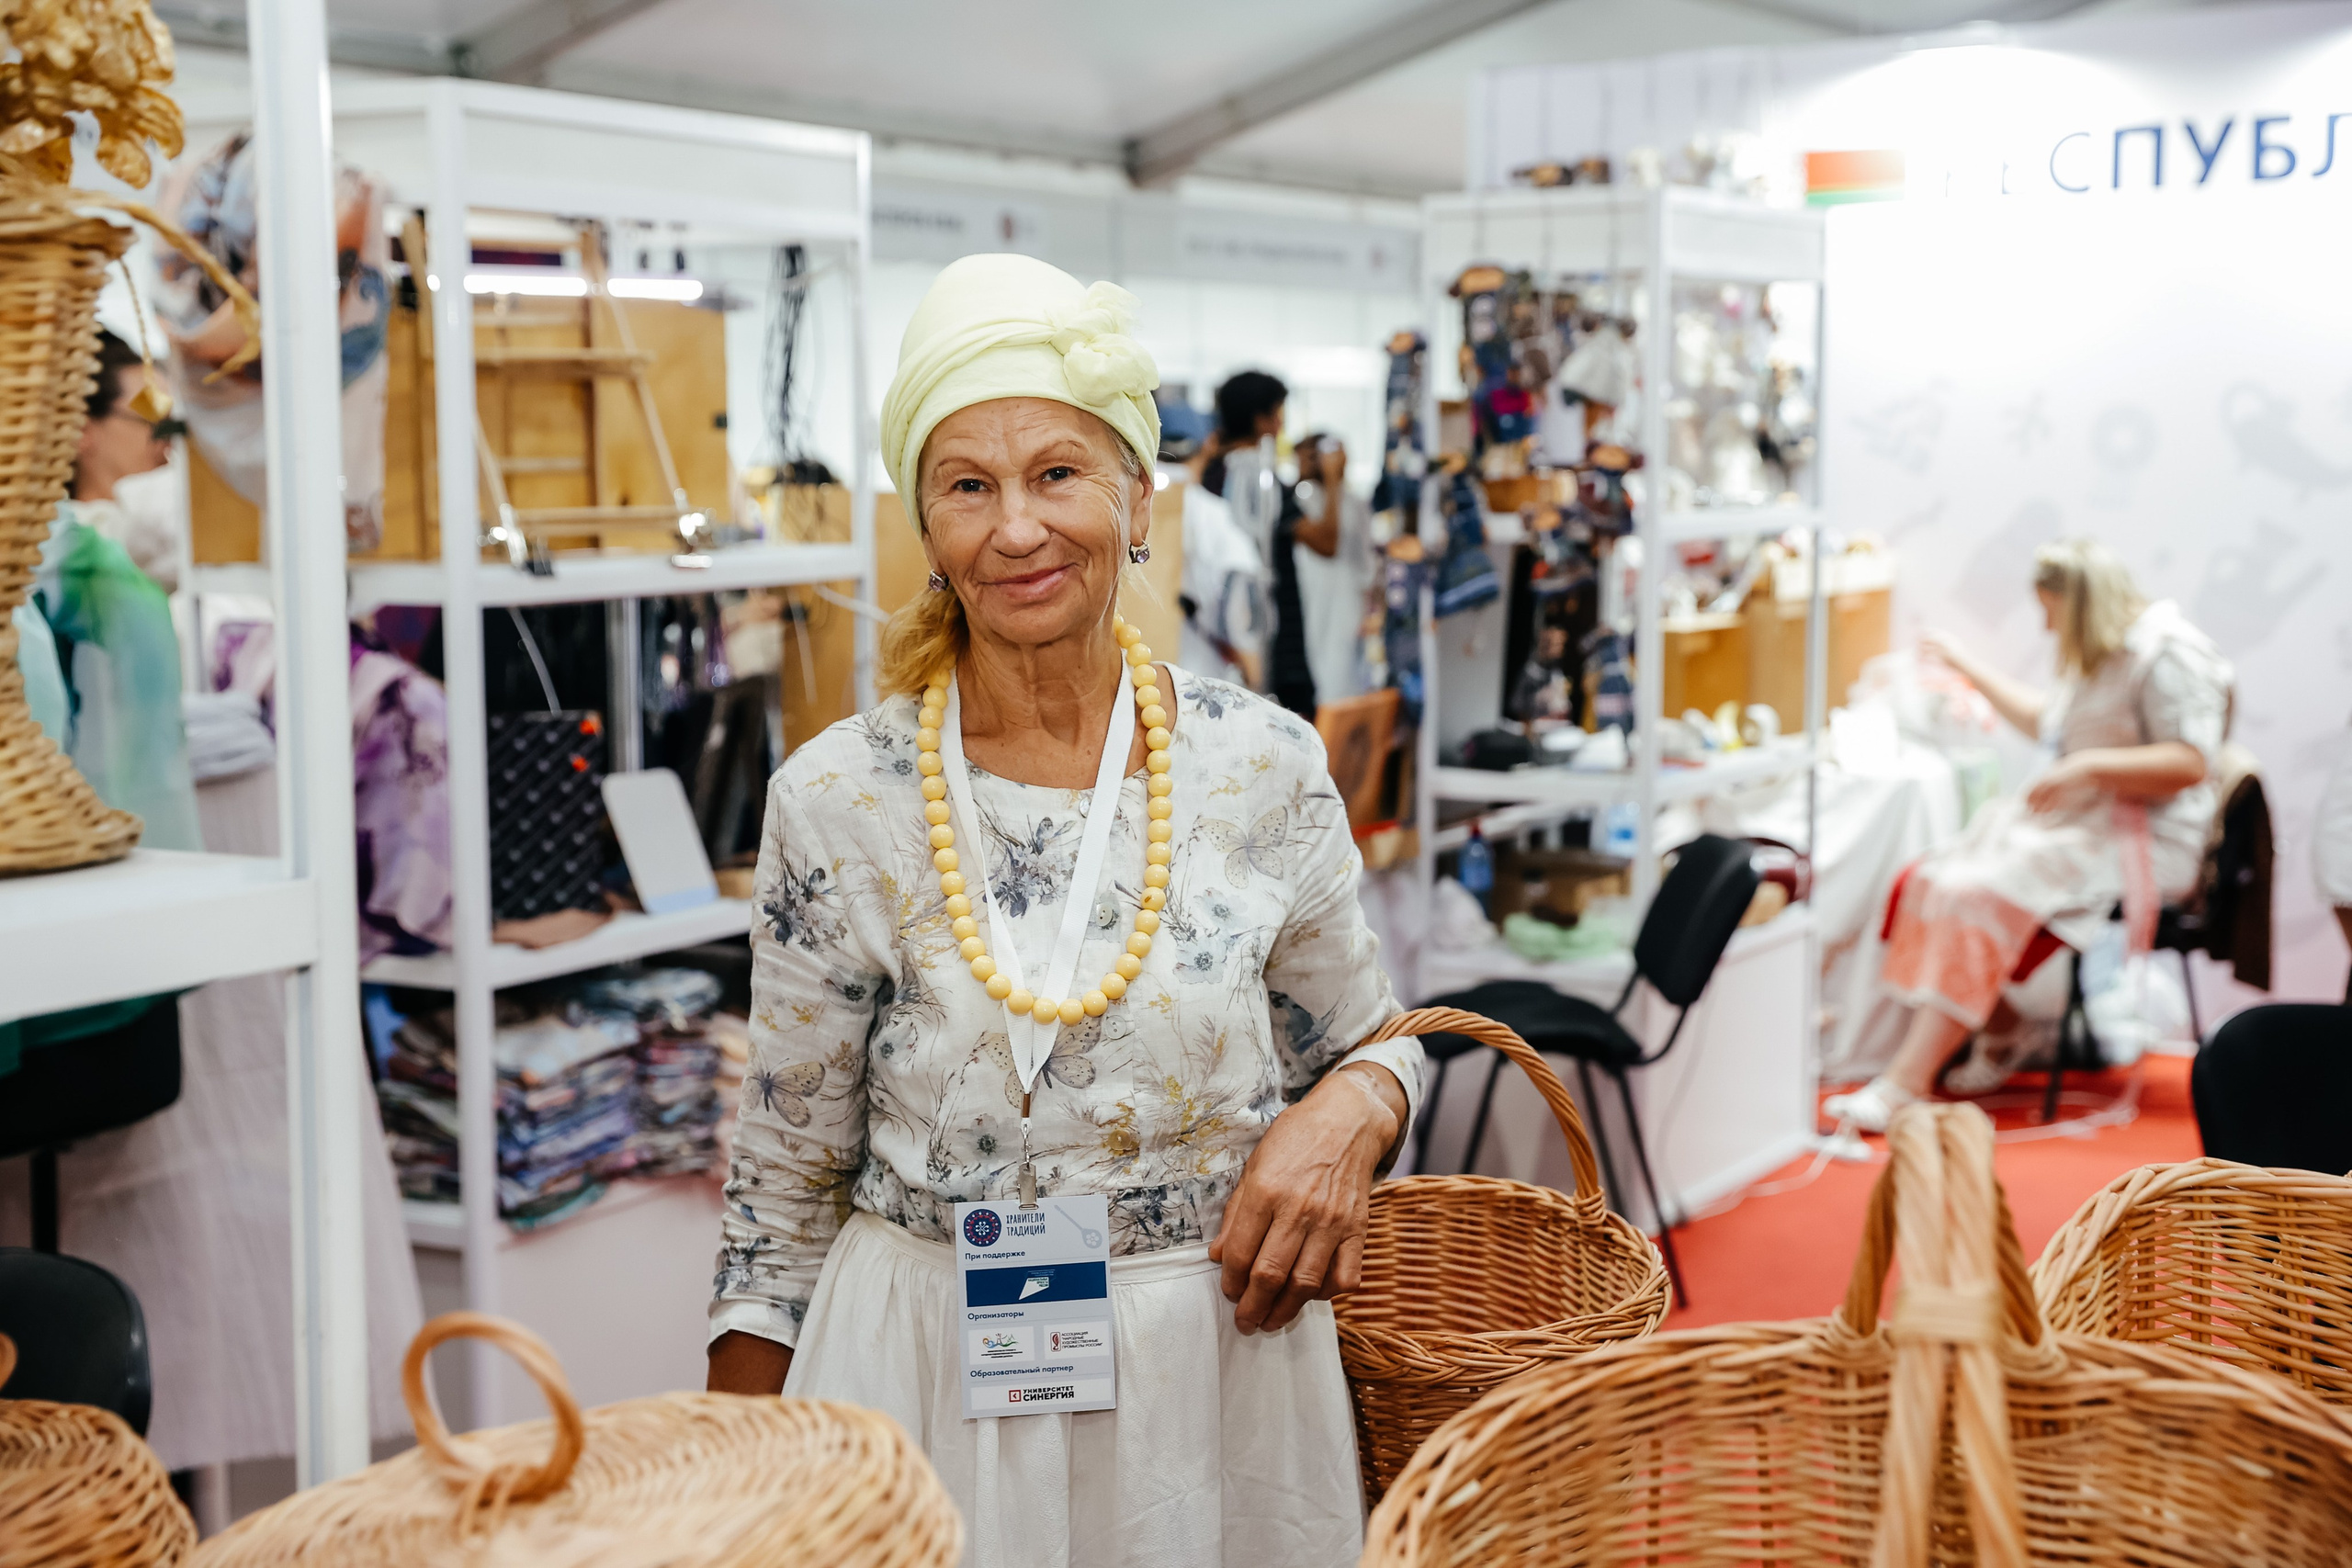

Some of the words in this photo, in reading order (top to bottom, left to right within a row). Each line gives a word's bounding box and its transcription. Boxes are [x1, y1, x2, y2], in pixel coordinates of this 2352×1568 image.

[1943, 112, 2352, 199] СПУБЛ
[1006, 1213, 1046, 1224] ХРАНИТЕЛИ
[1006, 1223, 1046, 1236] ТРАДИЦИЙ
[965, 1252, 981, 1260] При
[982, 1250, 1025, 1259] поддержке
[967, 1312, 1024, 1321] Организаторы
[970, 1367, 1041, 1378] Образовательный
[1042, 1365, 1074, 1373] партнер
[1023, 1385, 1074, 1393] УНИВЕРСИТЕТ
[1023, 1391, 1075, 1402] СИНЕРГИЯ
